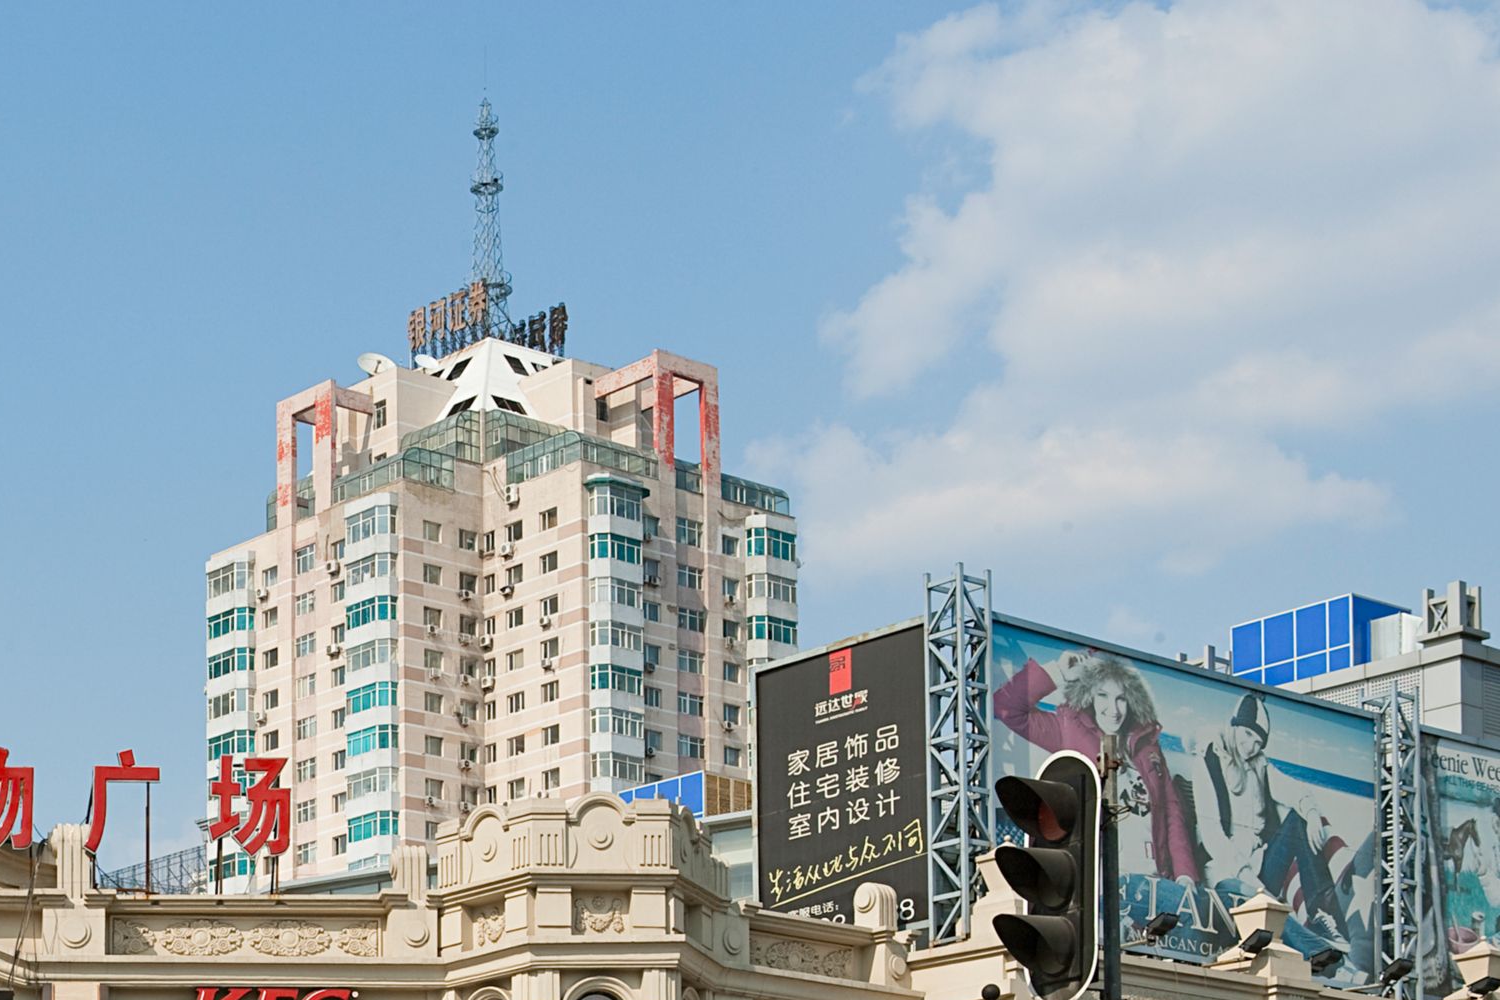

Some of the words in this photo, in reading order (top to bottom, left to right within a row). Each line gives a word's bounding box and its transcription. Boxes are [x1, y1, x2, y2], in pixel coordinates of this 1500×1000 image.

[408, 280, 488, 350] 银河证券
[787, 724, 899, 777] 家居饰品
[1430, 753, 1468, 775] eenie
[787, 758, 900, 809] 住宅装修
[788, 789, 900, 841] 室内设计
